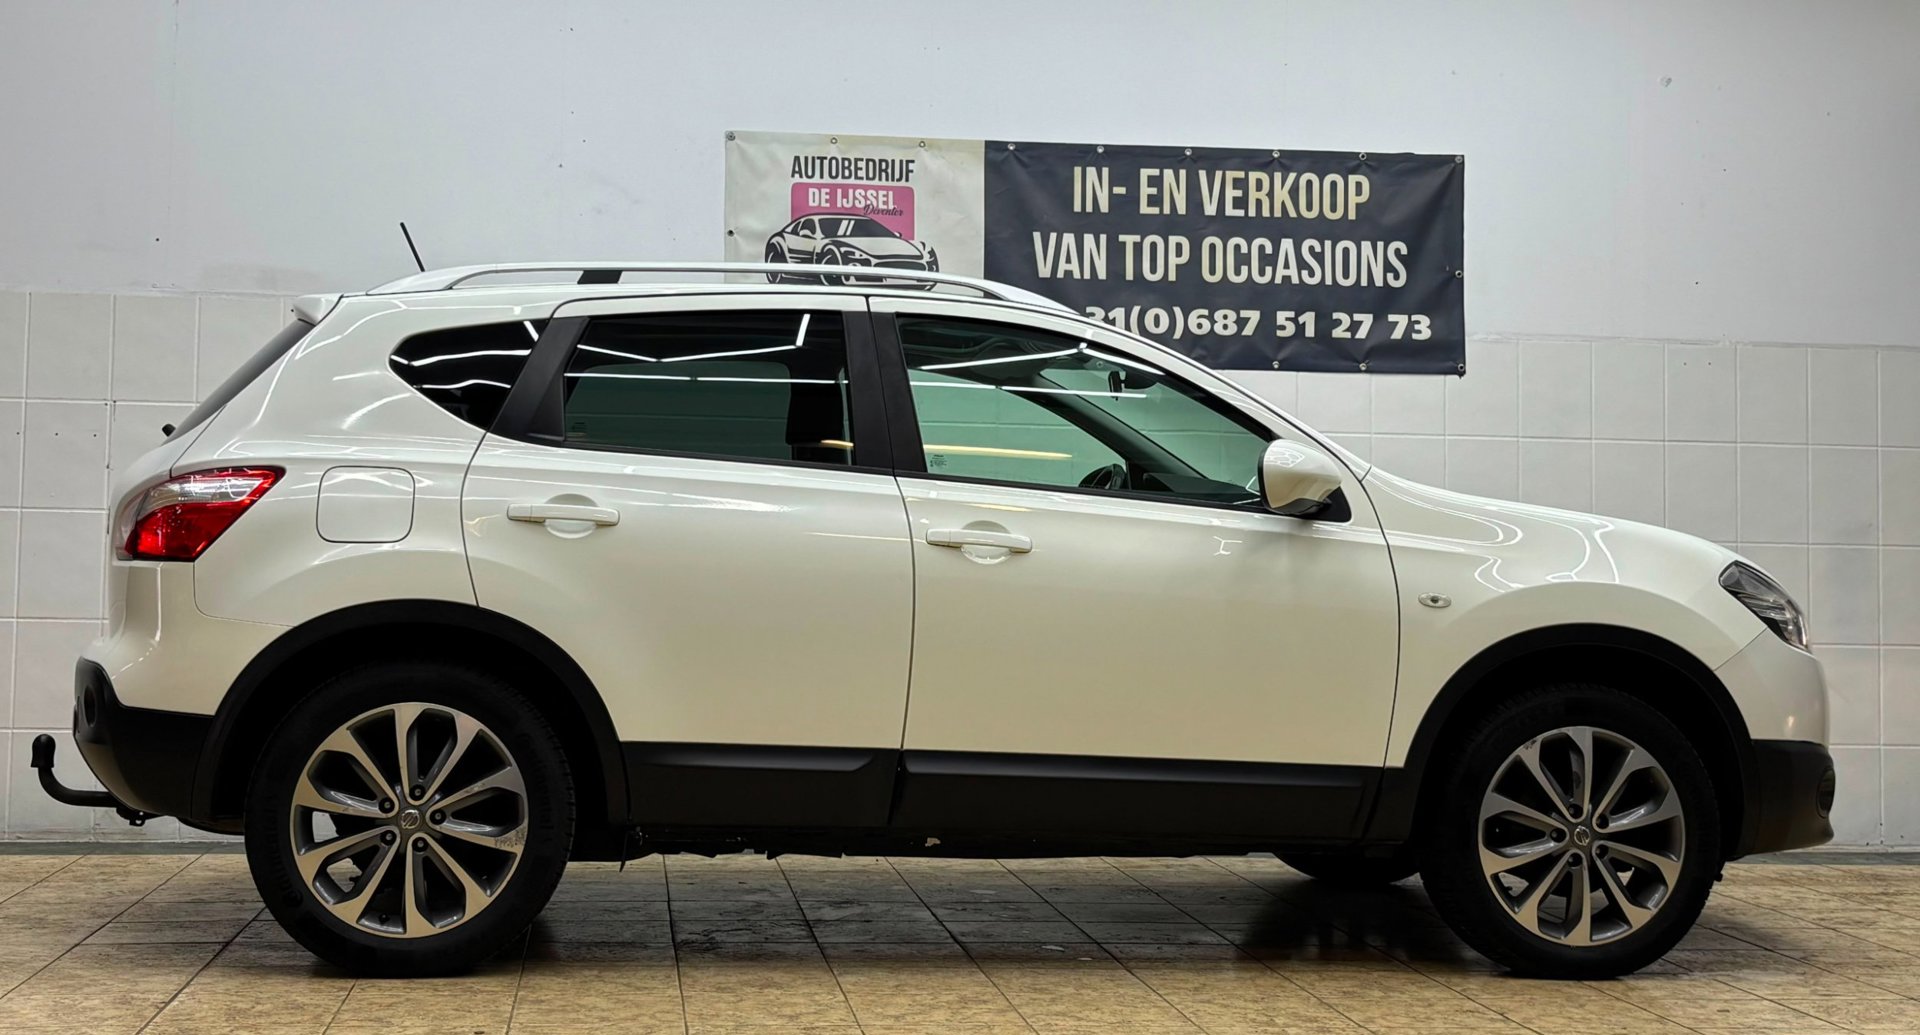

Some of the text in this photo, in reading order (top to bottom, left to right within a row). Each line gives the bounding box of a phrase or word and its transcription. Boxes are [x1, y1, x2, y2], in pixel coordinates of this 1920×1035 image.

[790, 155, 916, 183] AUTOBEDRIJF
[808, 187, 897, 210] DE IJSSEL
[1073, 166, 1370, 220] IN- EN VERKOOP
[1032, 231, 1408, 288] VAN TOP OCCASIONS
[1276, 311, 1316, 338] 51
[1331, 312, 1374, 339] 27
[1387, 314, 1432, 340] 73
